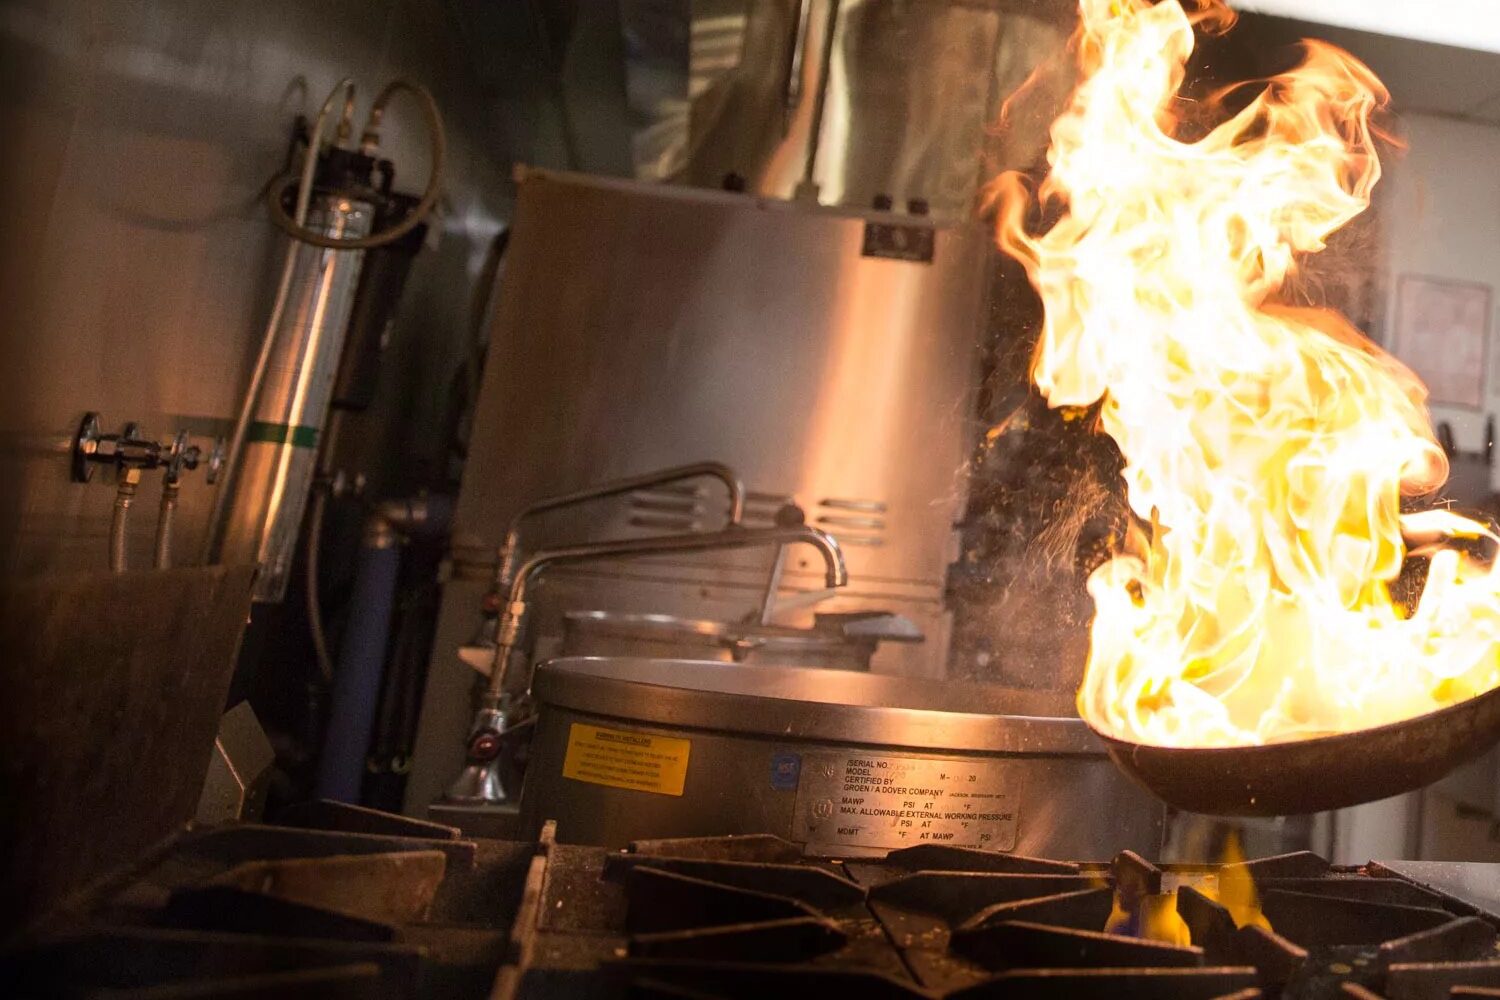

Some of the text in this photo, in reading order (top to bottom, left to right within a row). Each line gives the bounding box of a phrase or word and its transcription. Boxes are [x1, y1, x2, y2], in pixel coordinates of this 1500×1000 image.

[845, 767, 872, 776] MODEL
[844, 775, 882, 785] CERTIFIED
[883, 778, 894, 786] BY
[843, 784, 870, 792] GROEN
[882, 787, 907, 795] DOVER
[909, 788, 944, 796] COMPANY
[841, 797, 865, 805] MAWP
[860, 808, 905, 817] ALLOWABLE
[906, 810, 943, 819] EXTERNAL
[944, 812, 977, 820] WORKING
[978, 813, 1012, 821] PRESSURE
[837, 827, 860, 836] MDMT
[932, 832, 954, 840] MAWP
